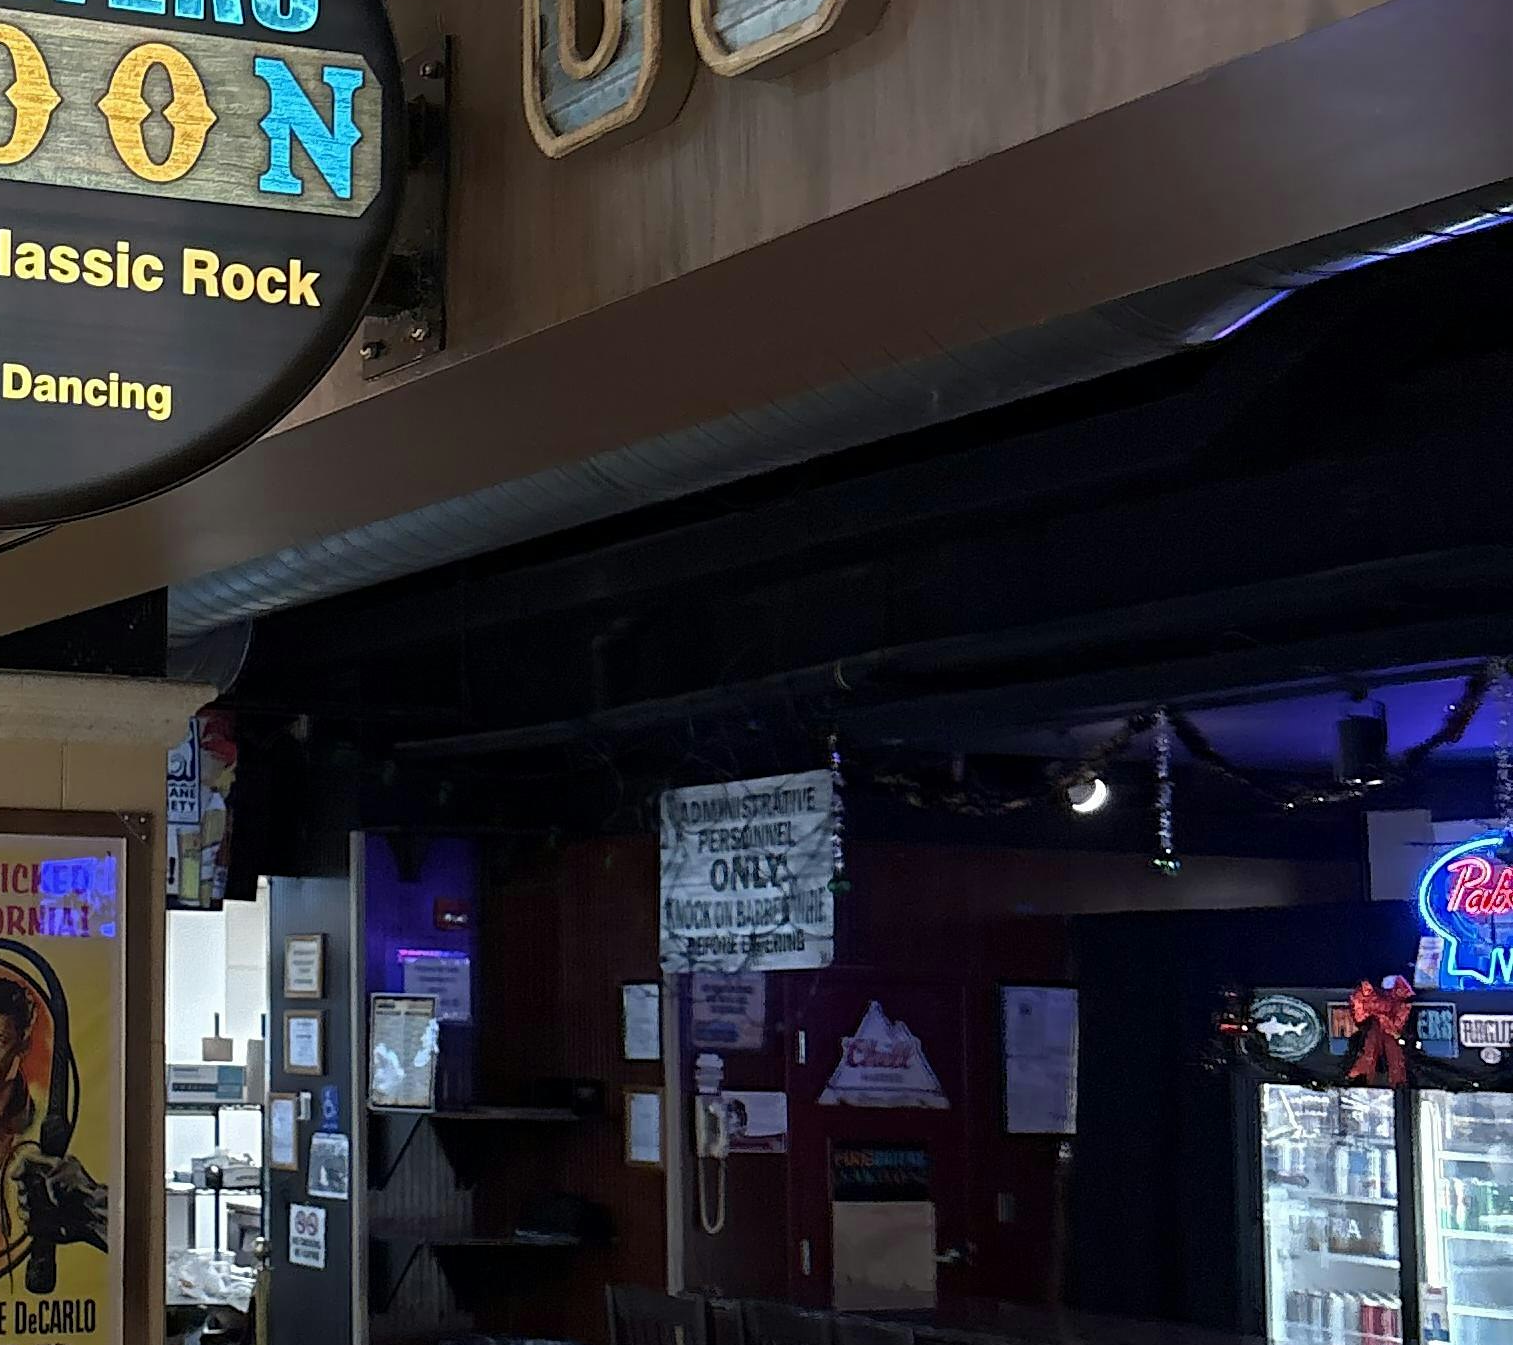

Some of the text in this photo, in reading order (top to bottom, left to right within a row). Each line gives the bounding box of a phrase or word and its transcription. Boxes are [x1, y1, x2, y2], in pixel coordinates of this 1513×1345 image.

[182, 247, 321, 307] Rock
[2, 362, 173, 422] Dancing
[15, 1298, 97, 1335] DeCARLO
